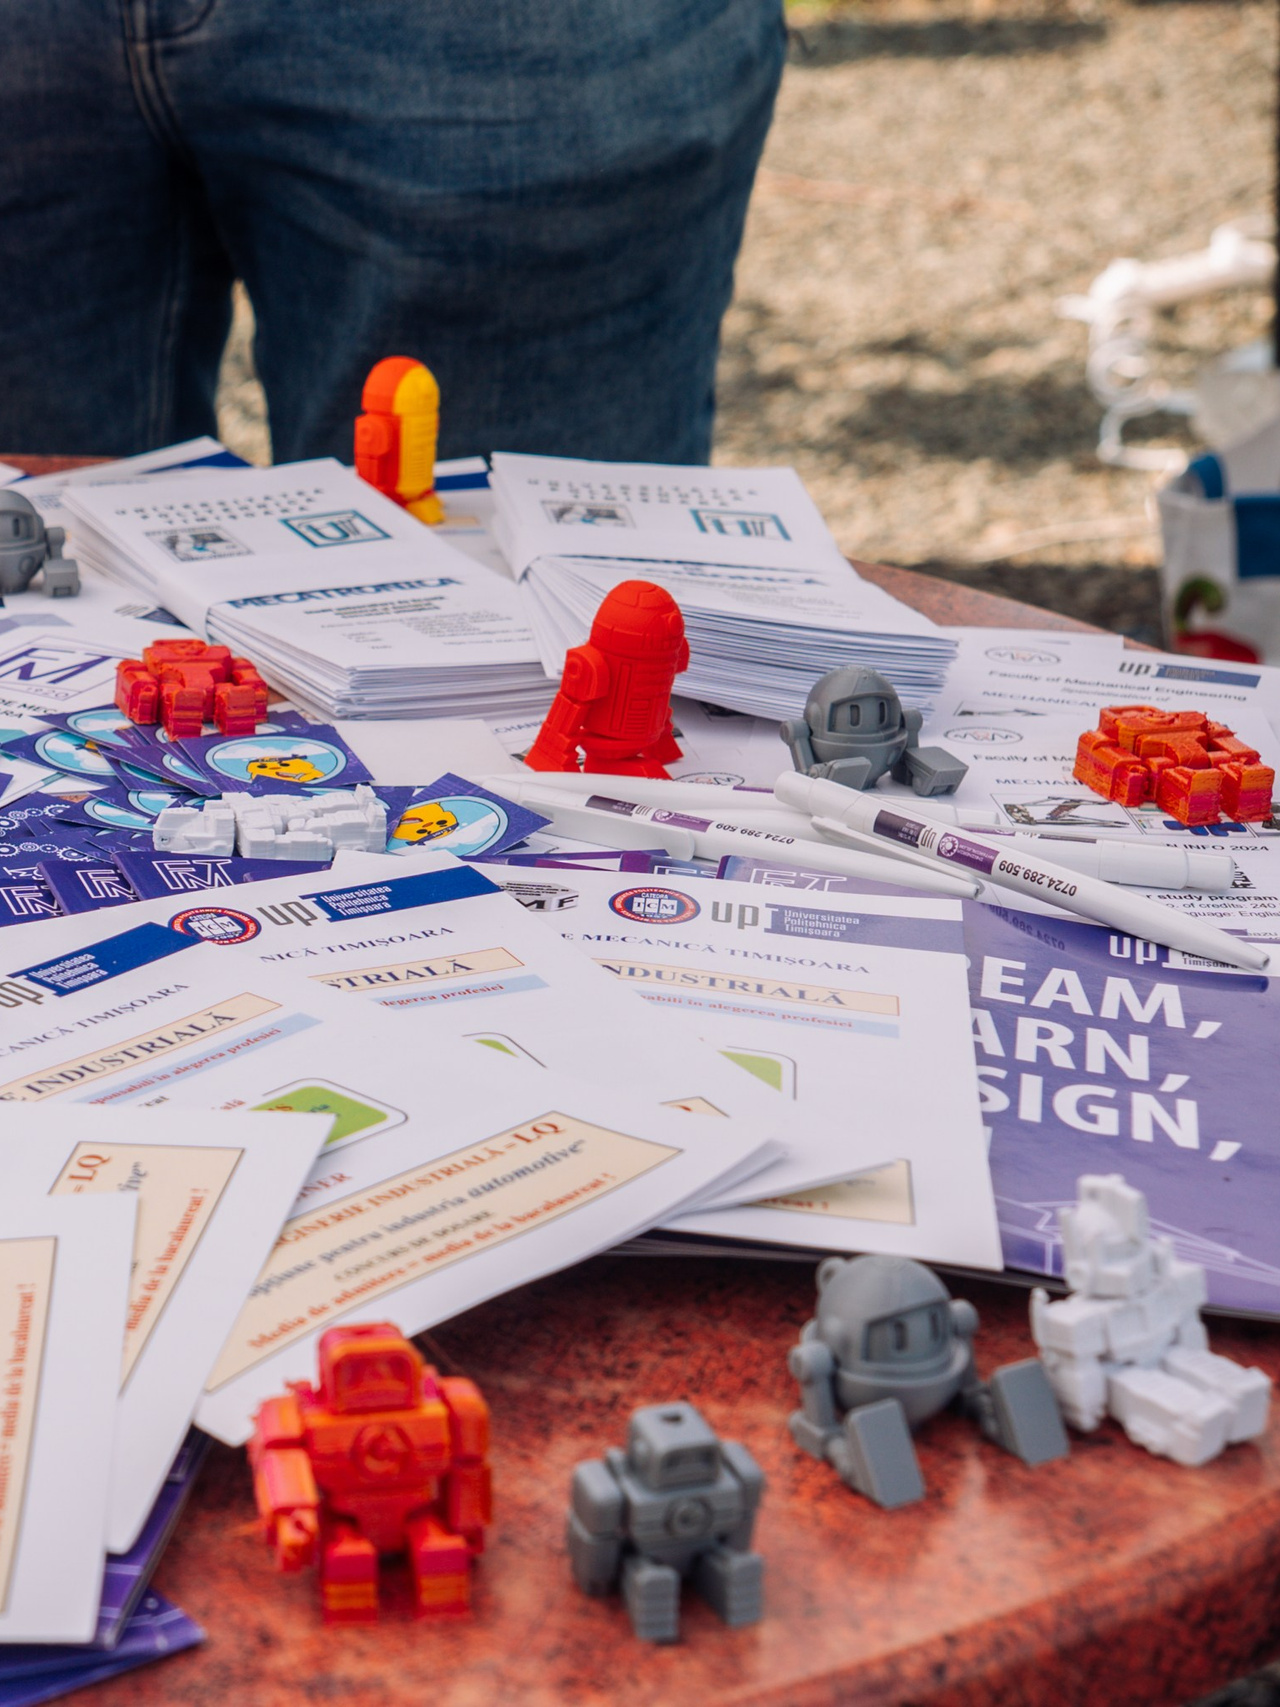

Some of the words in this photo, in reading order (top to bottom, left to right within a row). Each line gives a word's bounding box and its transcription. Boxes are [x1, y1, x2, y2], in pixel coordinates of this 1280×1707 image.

[227, 577, 463, 610] MECATRONICA
[1184, 843, 1225, 851] INFO
[998, 859, 1078, 897] 0724.289.509
[320, 885, 393, 904] Universitatea
[329, 893, 389, 911] Politehnica
[1157, 893, 1202, 902] study
[1208, 894, 1279, 902] program
[336, 901, 391, 918] Timișoara
[784, 909, 860, 925] Universitatea
[784, 917, 847, 931] Politehnica
[785, 923, 841, 938] Timișoara
[321, 926, 455, 954] TIMIȘOARA
[582, 933, 717, 953] MECANICĂ
[725, 947, 870, 975] TIMIȘOARA
[441, 983, 504, 1000] profesiei
[72, 983, 190, 1030] TIMIȘOARA
[22, 1010, 238, 1096] INDUSTRIALĂ
[172, 1051, 225, 1077] alegerea
[227, 1026, 282, 1054] profesiei
[68, 1152, 112, 1183] LQ
[369, 1145, 506, 1210] INDUSTRIALĂ
[513, 1120, 567, 1147] LQ
